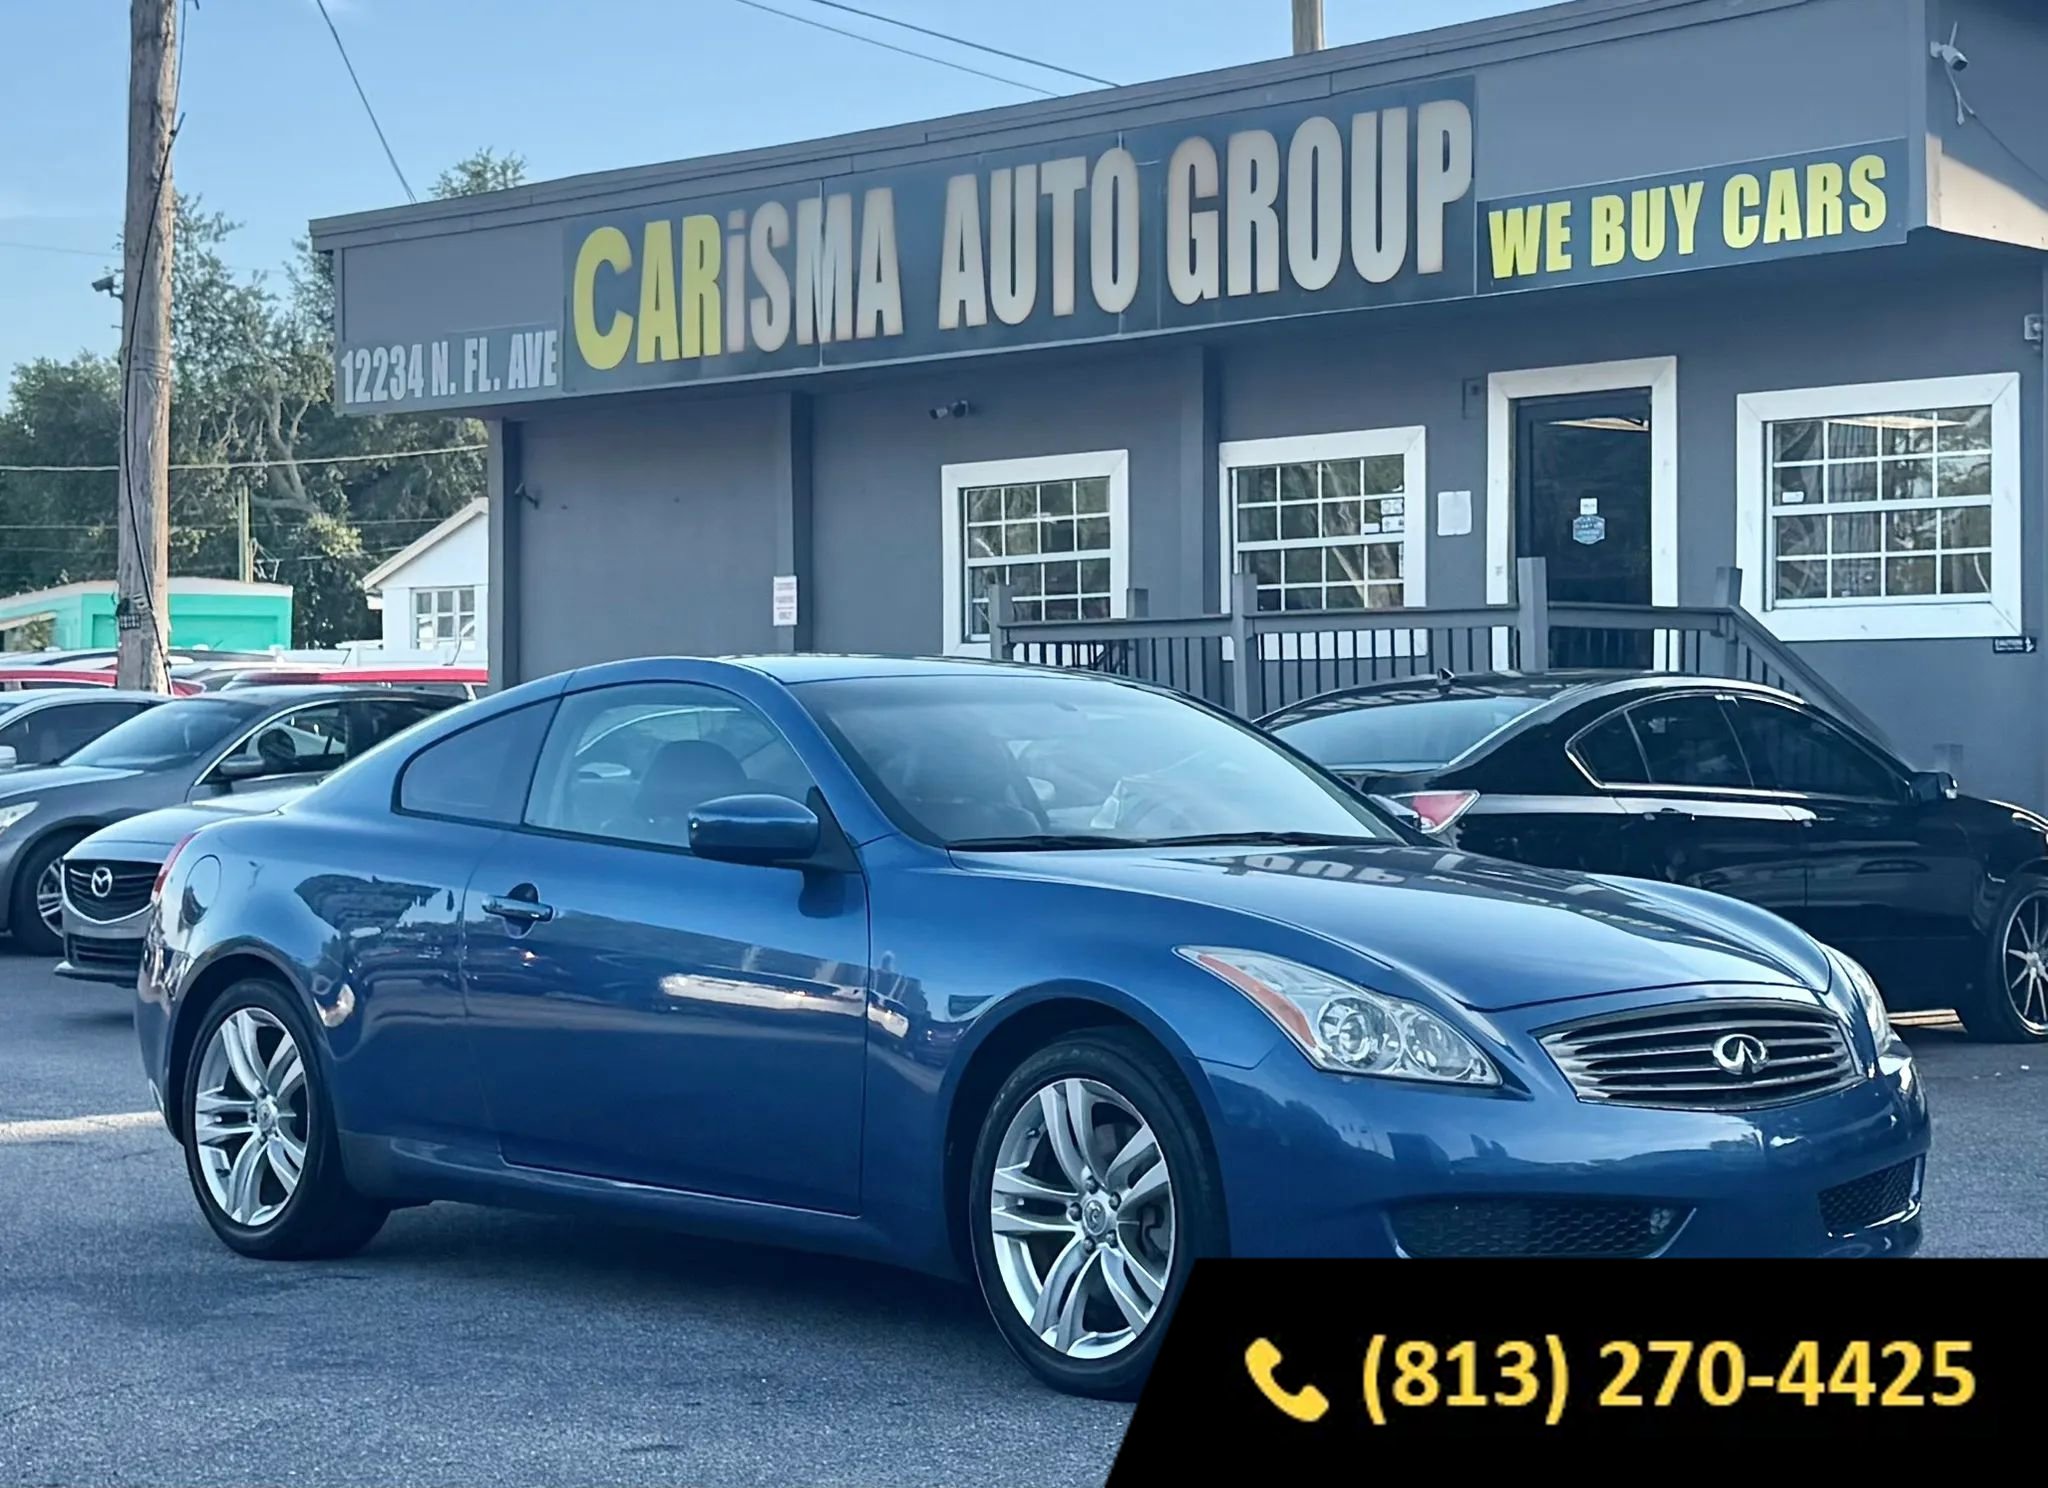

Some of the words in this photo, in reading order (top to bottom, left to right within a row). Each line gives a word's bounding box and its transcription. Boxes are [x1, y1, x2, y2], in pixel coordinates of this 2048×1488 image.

[574, 187, 903, 370] CARiSMA
[938, 148, 1140, 330] AUTO
[1167, 100, 1472, 305] GROUP
[1488, 201, 1572, 279] WE
[1591, 181, 1704, 267] BUY
[1723, 154, 1887, 249] CARS
[341, 344, 424, 404] 12234
[432, 341, 456, 397] N.
[464, 337, 500, 393] FL.
[508, 330, 557, 389] AVE
